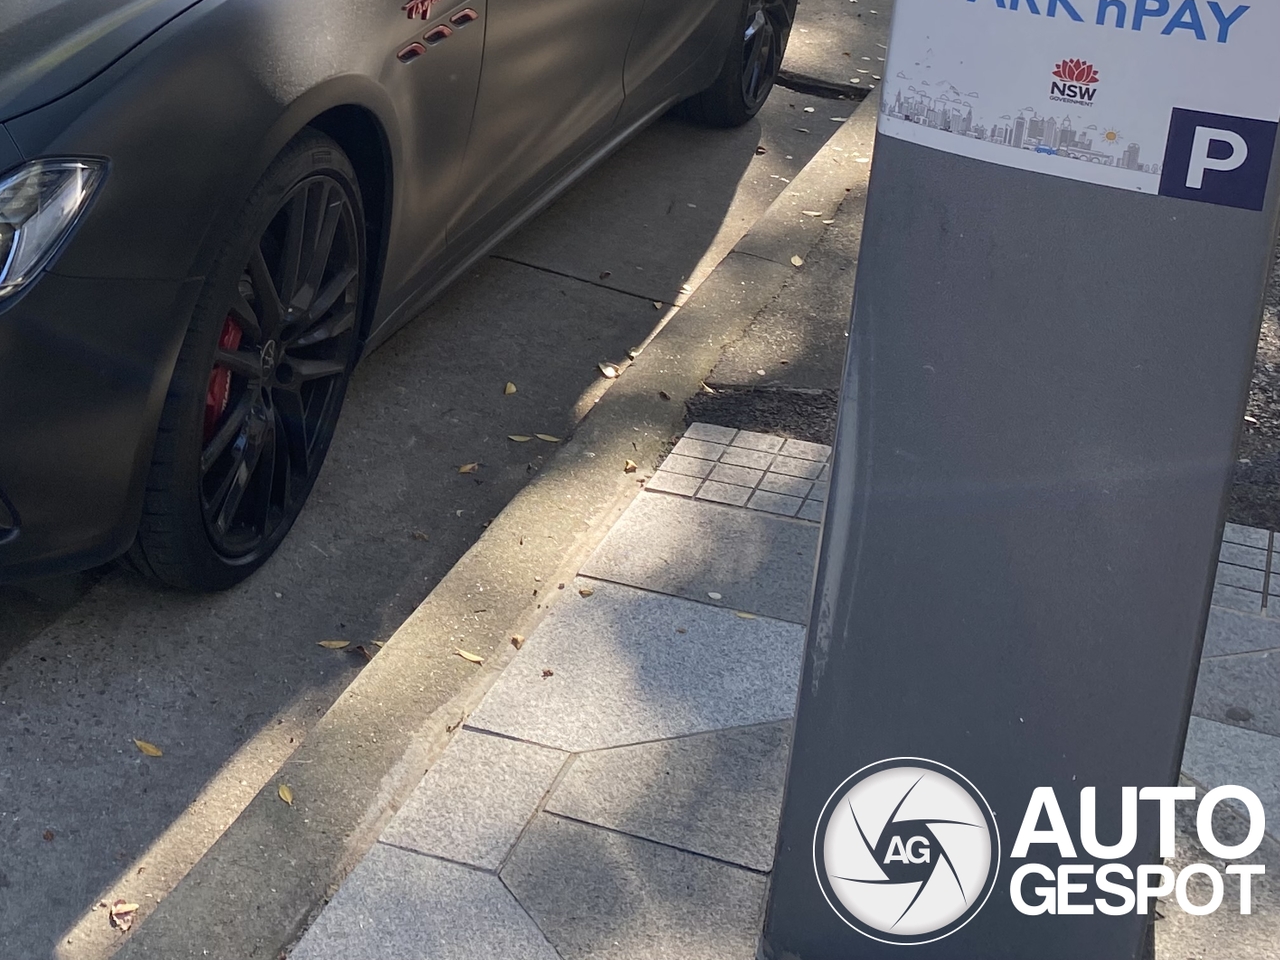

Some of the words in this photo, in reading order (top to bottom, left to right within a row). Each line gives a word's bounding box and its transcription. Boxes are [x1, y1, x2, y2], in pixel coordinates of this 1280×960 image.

[1049, 95, 1094, 107] GOVERNMENT
[1050, 81, 1097, 102] NSW
[1184, 125, 1248, 189] P
